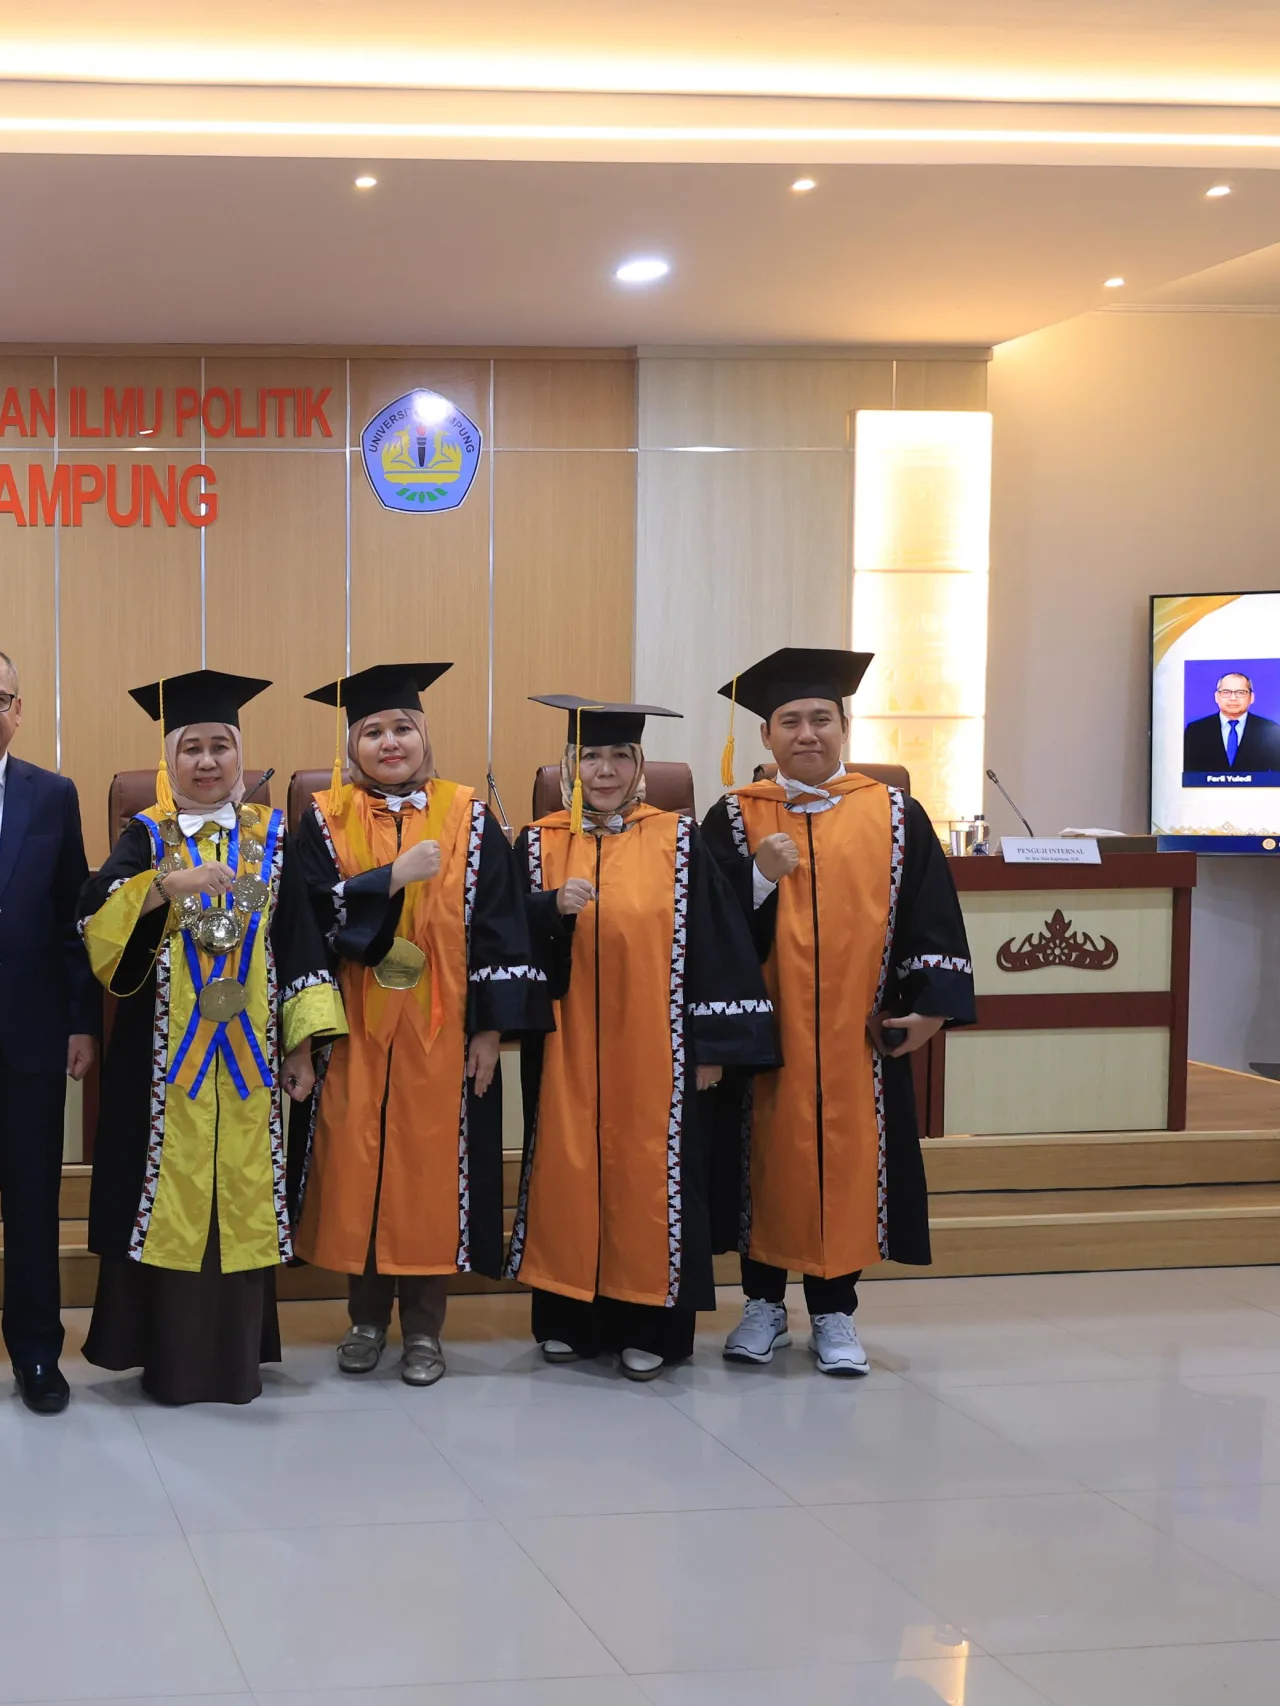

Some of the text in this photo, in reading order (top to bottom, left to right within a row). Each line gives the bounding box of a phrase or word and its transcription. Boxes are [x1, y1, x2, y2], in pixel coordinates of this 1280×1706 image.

[69, 386, 163, 438] ILMU
[174, 386, 334, 439] POLITIK
[368, 407, 475, 454] UNIVERSIT MPUNG
